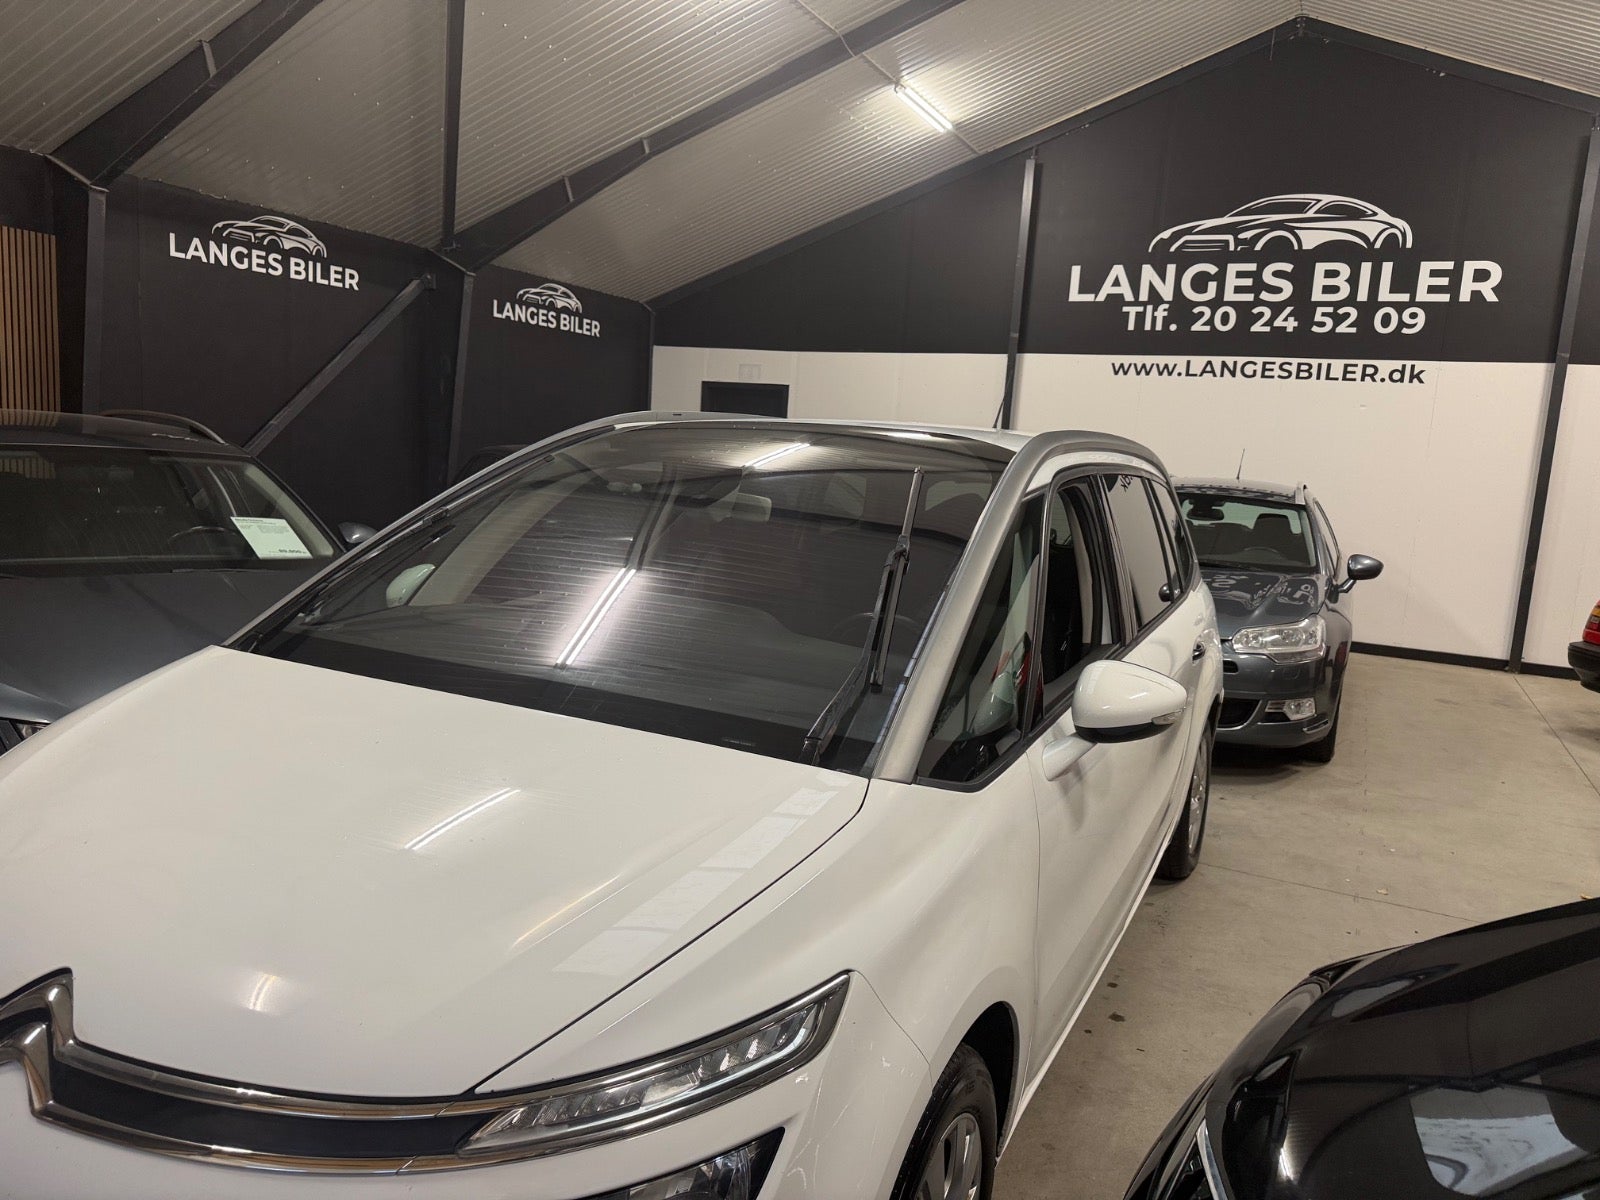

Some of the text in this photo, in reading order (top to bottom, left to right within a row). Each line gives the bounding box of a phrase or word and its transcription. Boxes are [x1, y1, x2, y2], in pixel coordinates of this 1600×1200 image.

[169, 232, 360, 291] LANGES BILER
[1068, 261, 1503, 303] LANGES BILER
[492, 299, 601, 338] LANGES BILER
[1122, 304, 1426, 335] Tlf. 20 24 52 09
[1111, 360, 1427, 384] www.LANGESBILER.dk
